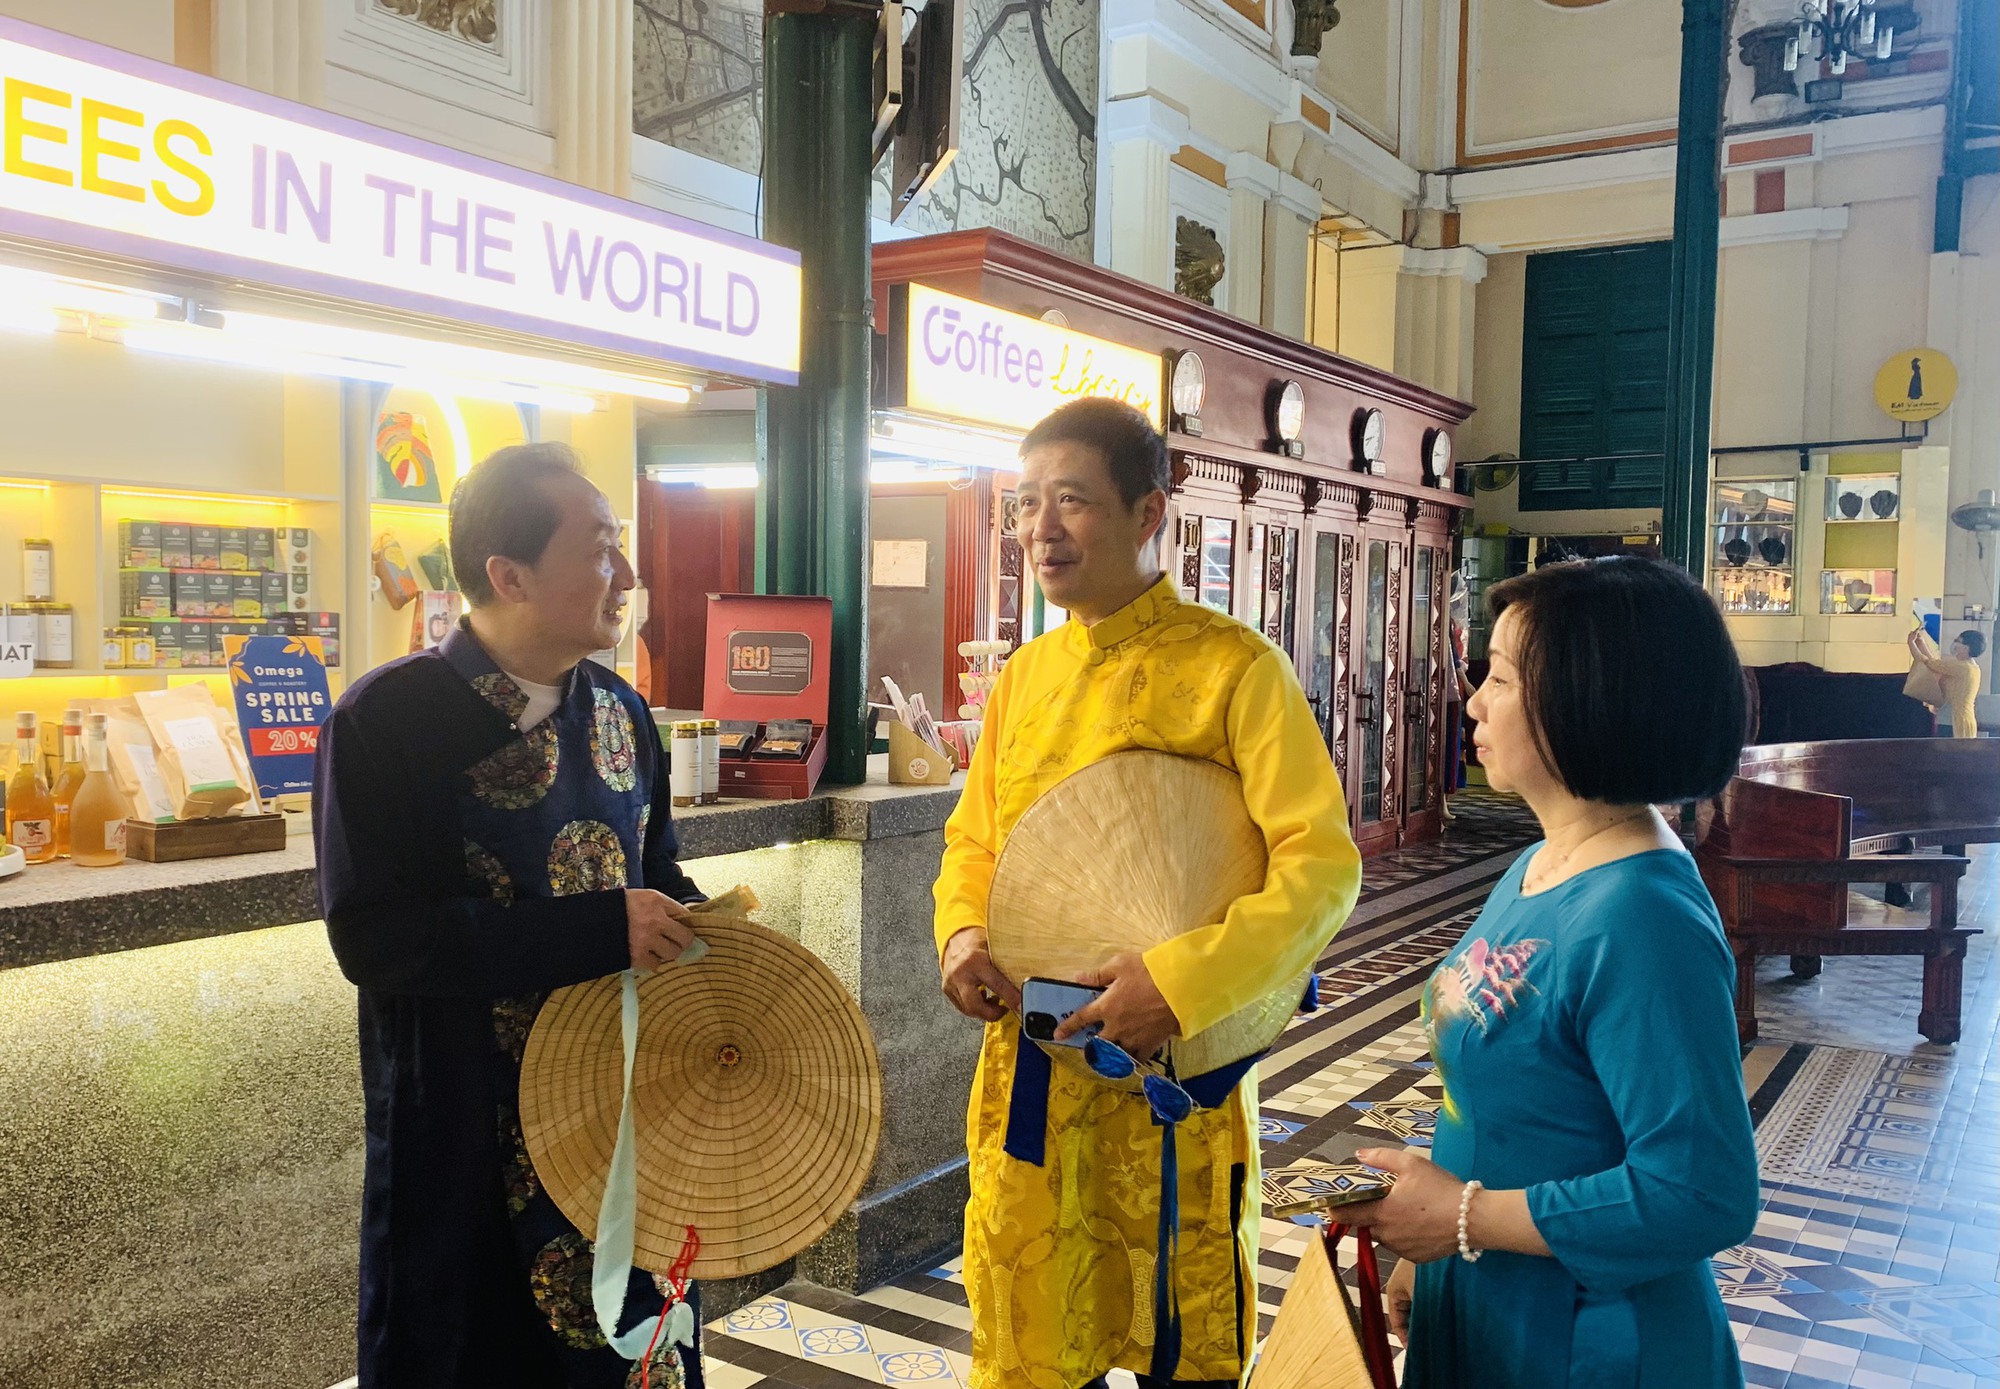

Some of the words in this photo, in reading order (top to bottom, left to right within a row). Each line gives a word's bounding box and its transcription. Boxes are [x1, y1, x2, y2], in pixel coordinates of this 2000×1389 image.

[4, 77, 215, 217] EES
[251, 143, 333, 246] IN
[364, 173, 516, 285] THE
[543, 221, 760, 337] WORLD
[923, 305, 1044, 389] Coffee
[1186, 523, 1200, 549] 10
[0, 645, 32, 663] ẠT
[254, 666, 304, 677] Omega
[245, 691, 324, 708] SPRING
[261, 707, 315, 723] SALE
[268, 730, 317, 751] 20%
